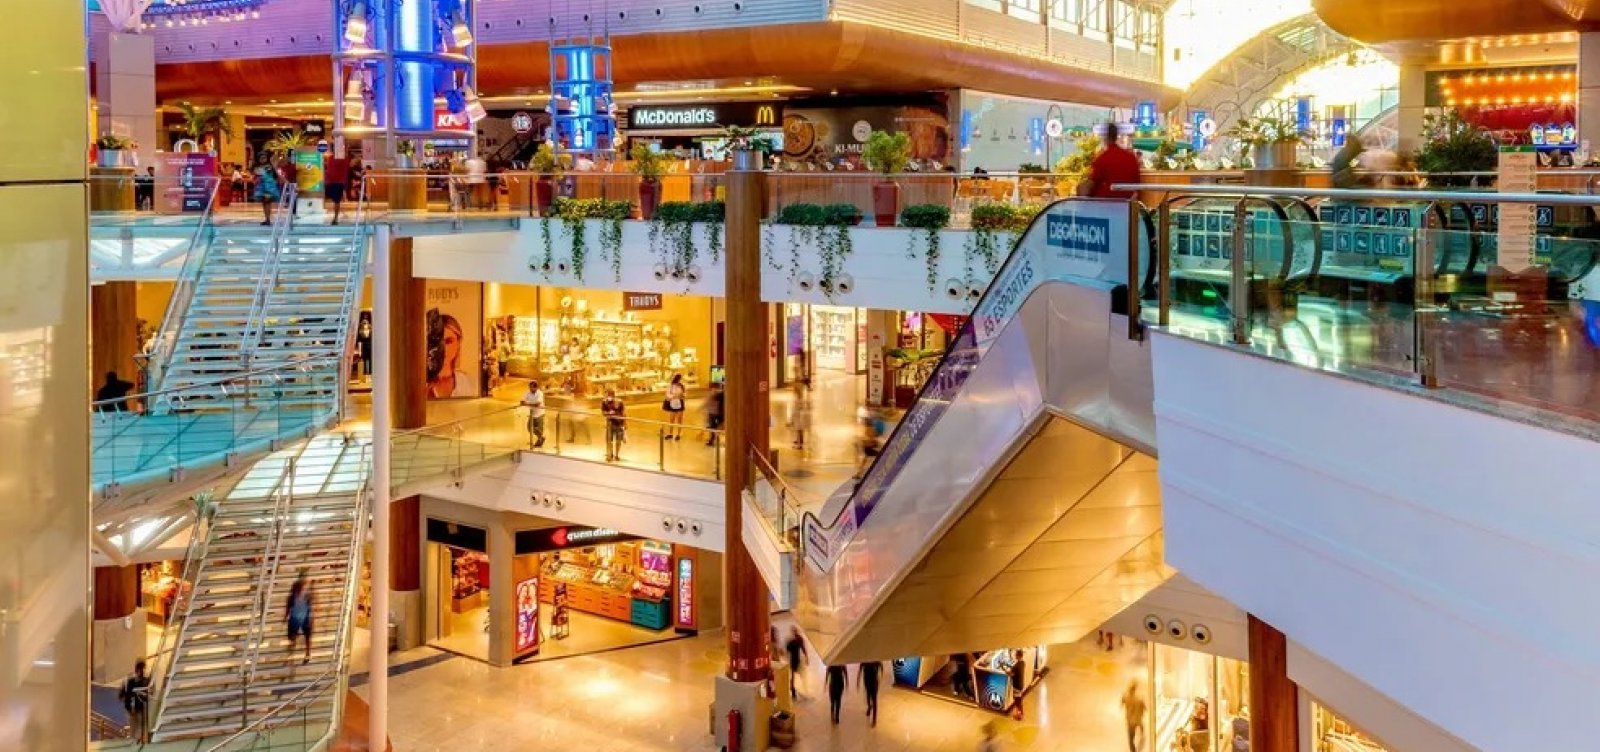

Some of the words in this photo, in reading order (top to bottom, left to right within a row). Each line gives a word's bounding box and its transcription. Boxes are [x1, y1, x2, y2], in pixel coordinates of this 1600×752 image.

[635, 108, 715, 124] McDonald's
[835, 143, 864, 153] KI-MU
[1050, 221, 1105, 245] DECATHLON
[993, 260, 1033, 324] ESPORTES
